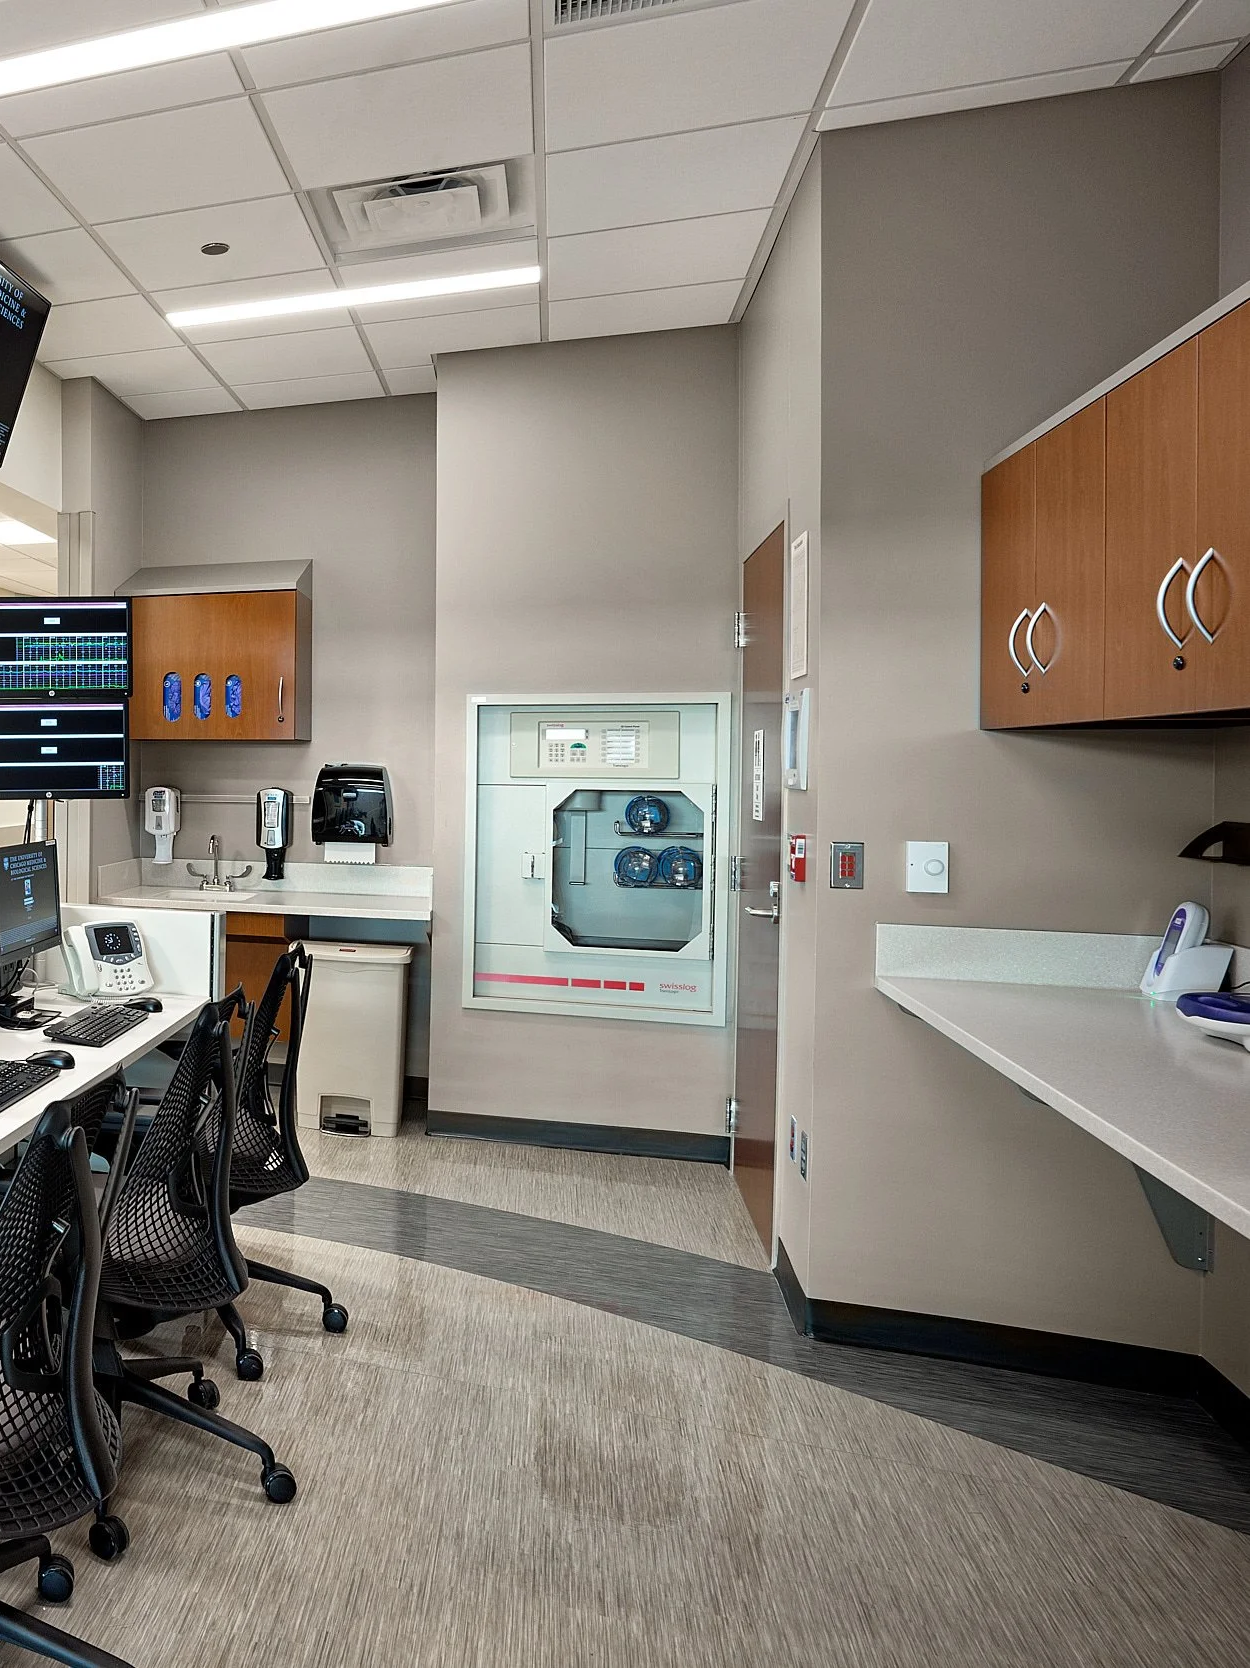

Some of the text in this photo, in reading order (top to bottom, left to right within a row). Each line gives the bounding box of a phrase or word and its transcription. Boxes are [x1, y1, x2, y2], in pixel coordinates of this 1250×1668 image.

[14, 288, 23, 300] OF
[21, 308, 27, 318] &
[659, 982, 697, 992] swisslog
